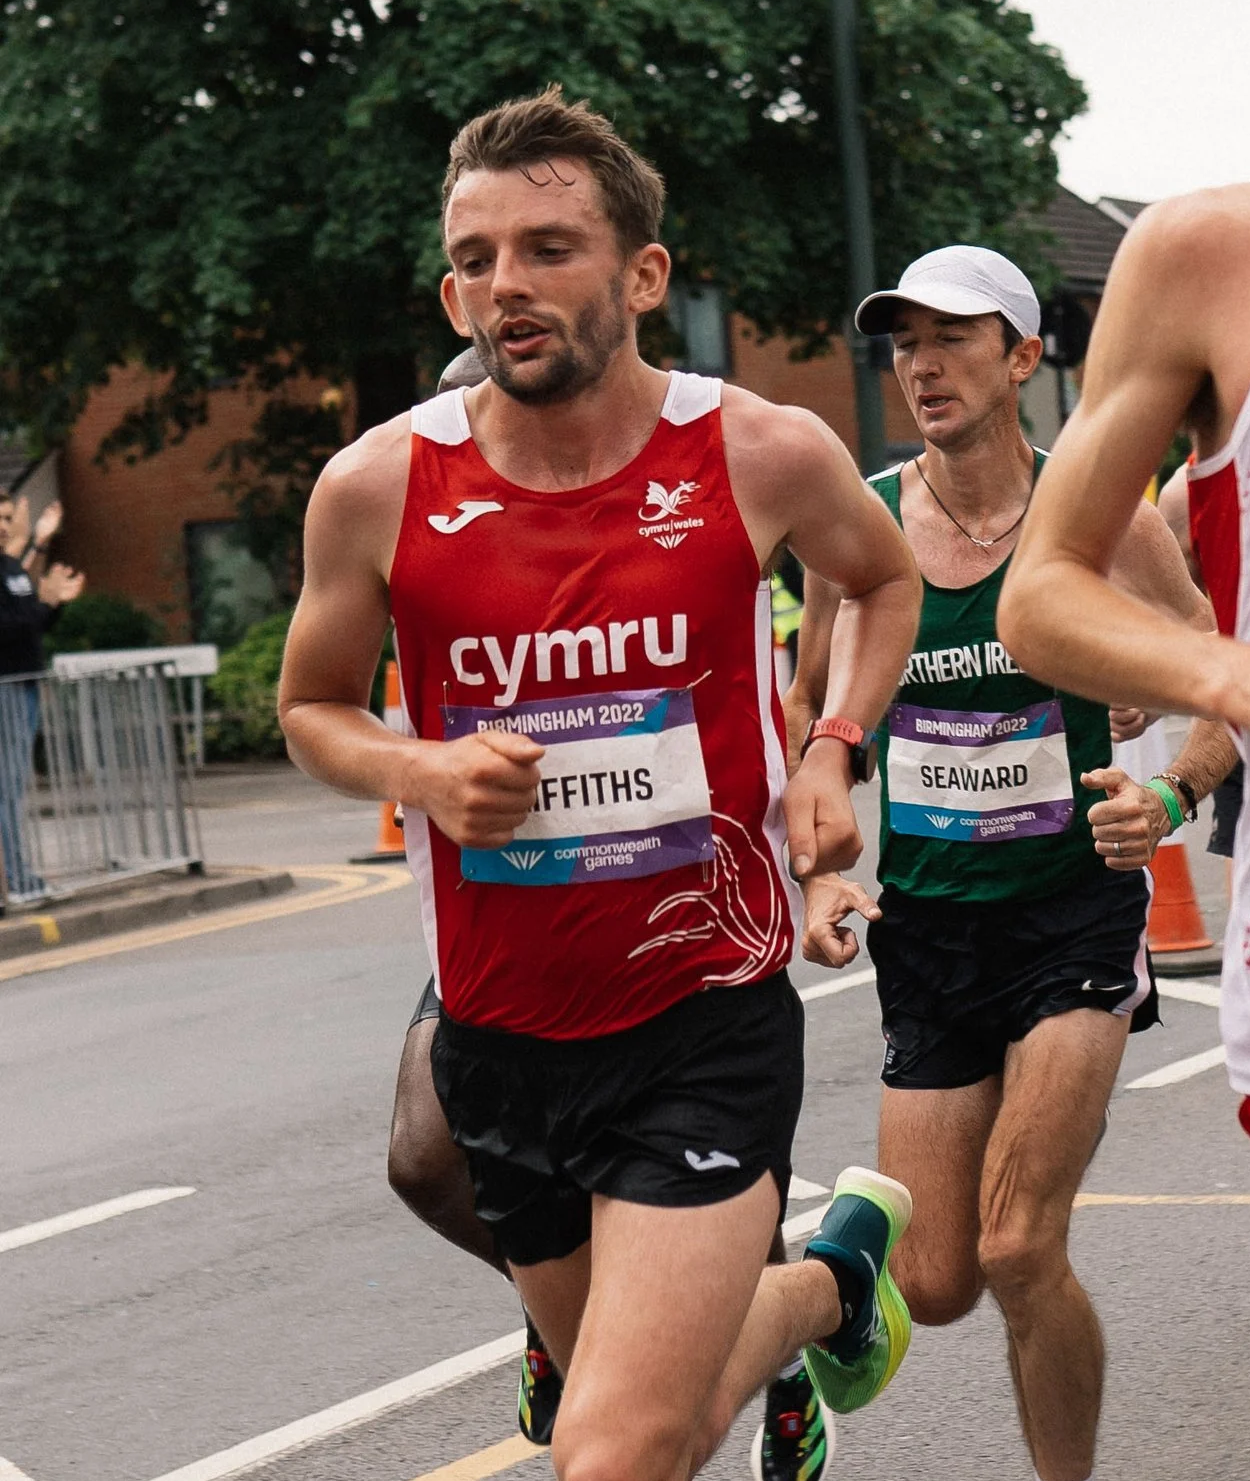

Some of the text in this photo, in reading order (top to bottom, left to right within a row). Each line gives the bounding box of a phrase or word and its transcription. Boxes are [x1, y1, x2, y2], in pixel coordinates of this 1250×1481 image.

[449, 613, 688, 707] cymru
[898, 641, 1027, 686] RTHERN IRE
[598, 702, 646, 726] 2022
[915, 717, 1028, 738] BIRMINGHAM 2022
[920, 764, 1028, 792] SEAWARD
[527, 768, 655, 813] FFITHS
[959, 811, 1036, 827] commonwealth
[979, 822, 1016, 838] games
[553, 835, 662, 860] commonwealth
[584, 851, 634, 872] games
